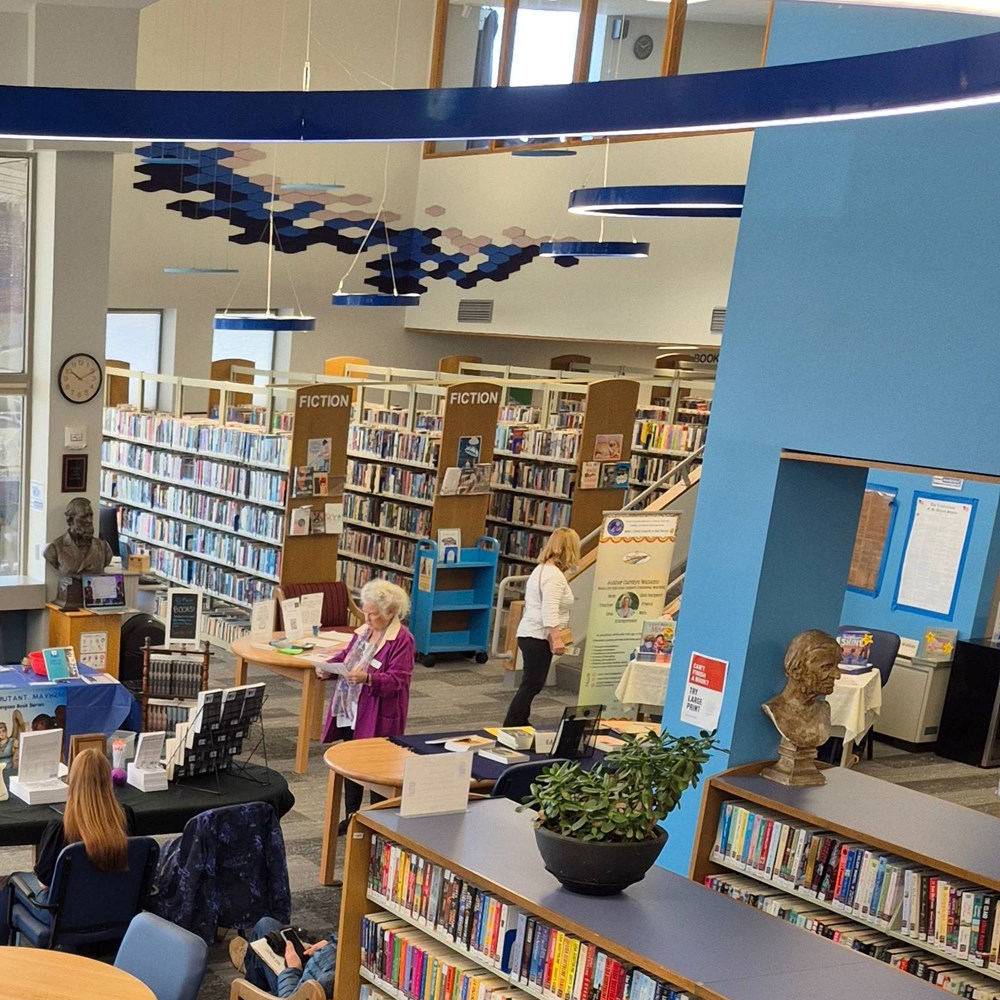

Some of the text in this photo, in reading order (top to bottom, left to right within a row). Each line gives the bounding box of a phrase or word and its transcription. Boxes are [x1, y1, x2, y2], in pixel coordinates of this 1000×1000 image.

[299, 394, 350, 408] FICTION
[450, 391, 498, 405] FICTION
[690, 687, 698, 695] TRY
[688, 695, 702, 705] LARGE
[687, 703, 700, 712] PRINT
